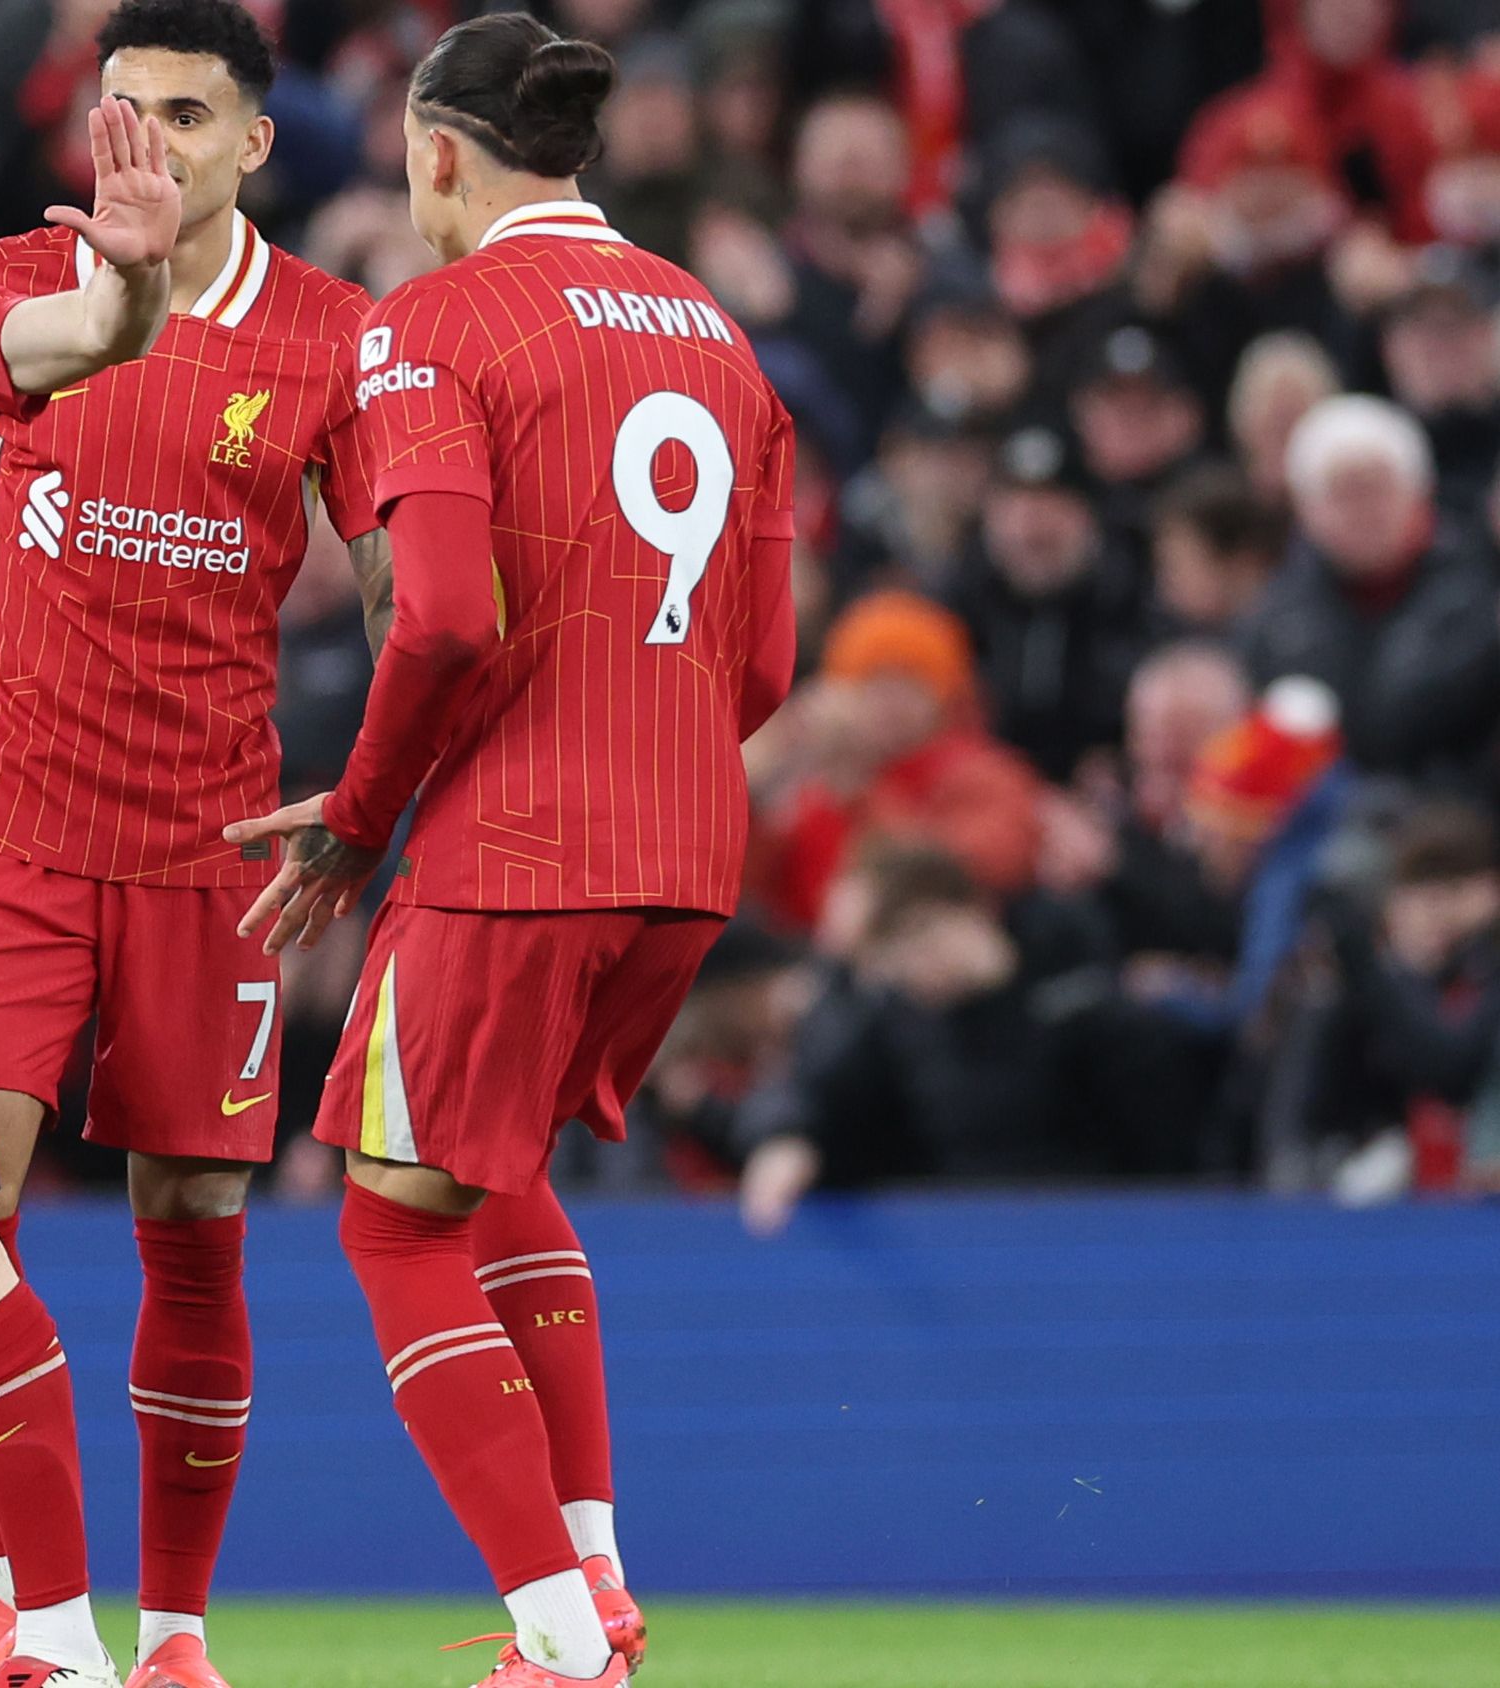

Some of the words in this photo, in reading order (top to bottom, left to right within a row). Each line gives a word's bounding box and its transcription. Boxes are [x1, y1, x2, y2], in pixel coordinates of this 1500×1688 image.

[563, 287, 733, 345] DARWIN
[355, 361, 436, 411] pedia
[79, 497, 242, 545] standard
[612, 390, 735, 645] 9
[75, 527, 250, 575] chartered
[237, 981, 276, 1079] 7
[533, 1309, 586, 1328] LFC
